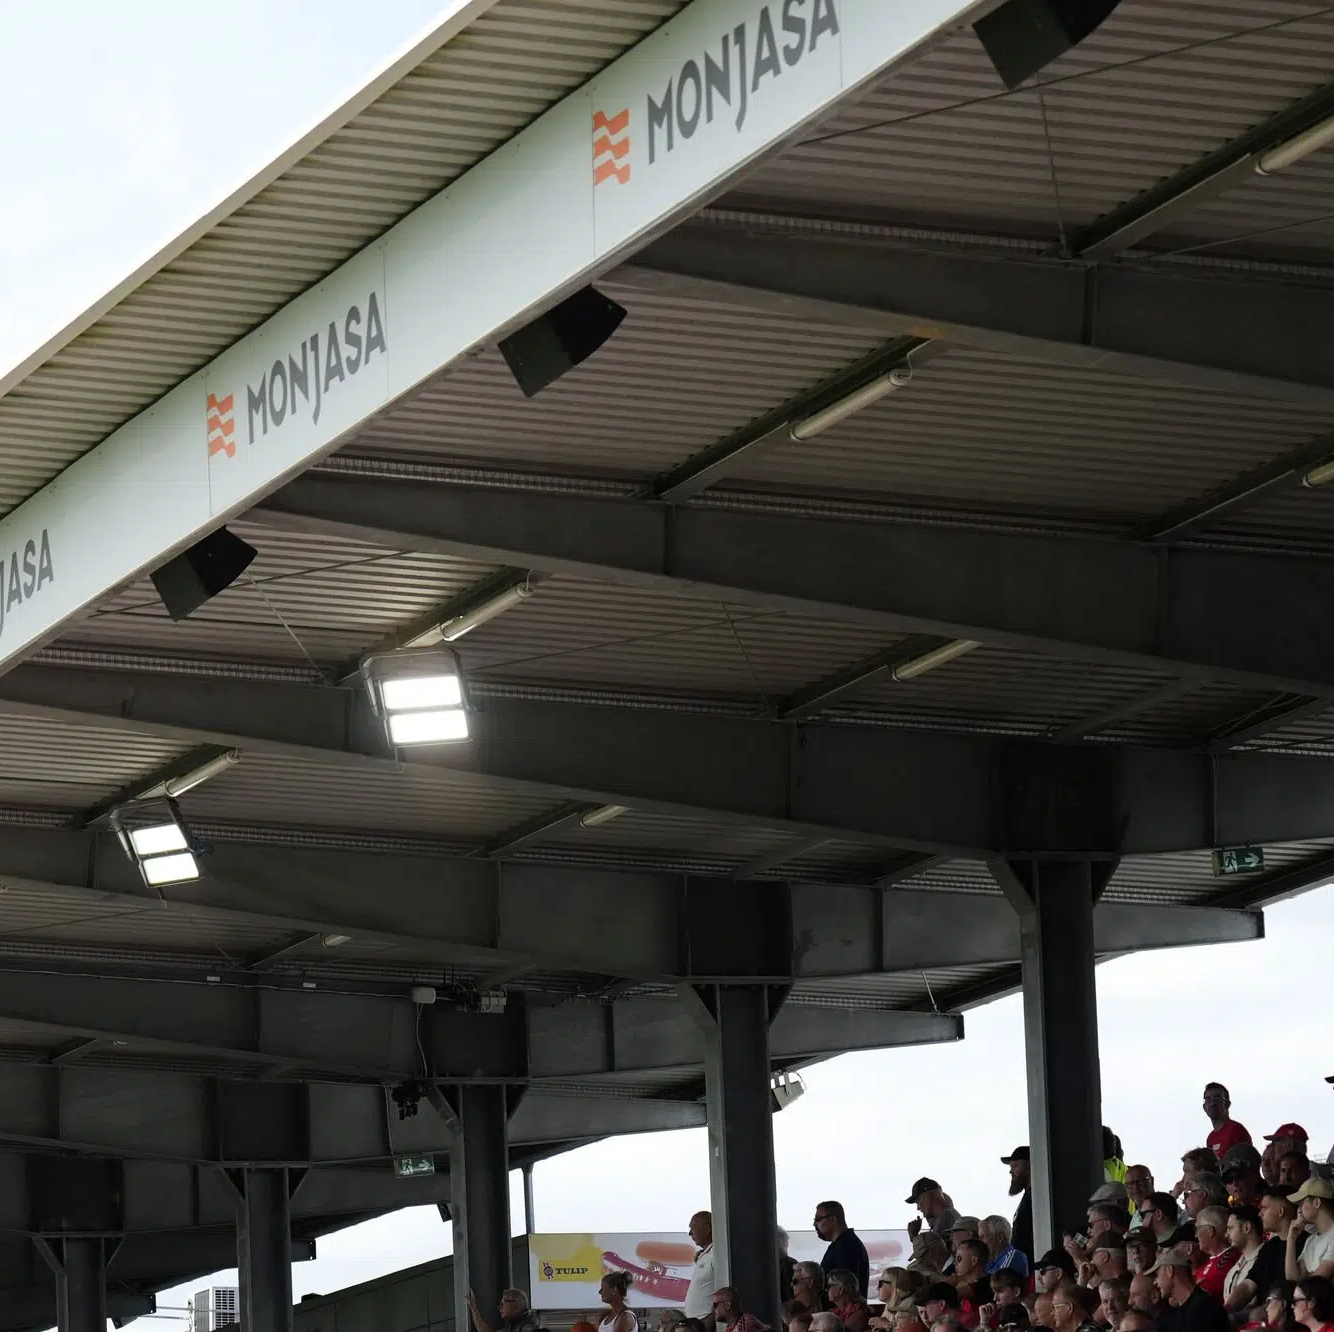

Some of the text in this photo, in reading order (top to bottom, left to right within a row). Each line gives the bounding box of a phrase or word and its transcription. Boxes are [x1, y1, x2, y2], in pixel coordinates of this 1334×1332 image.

[647, 0, 840, 164] MONJASA
[246, 292, 386, 444] MONJASA
[555, 1267, 588, 1275] TULIP
